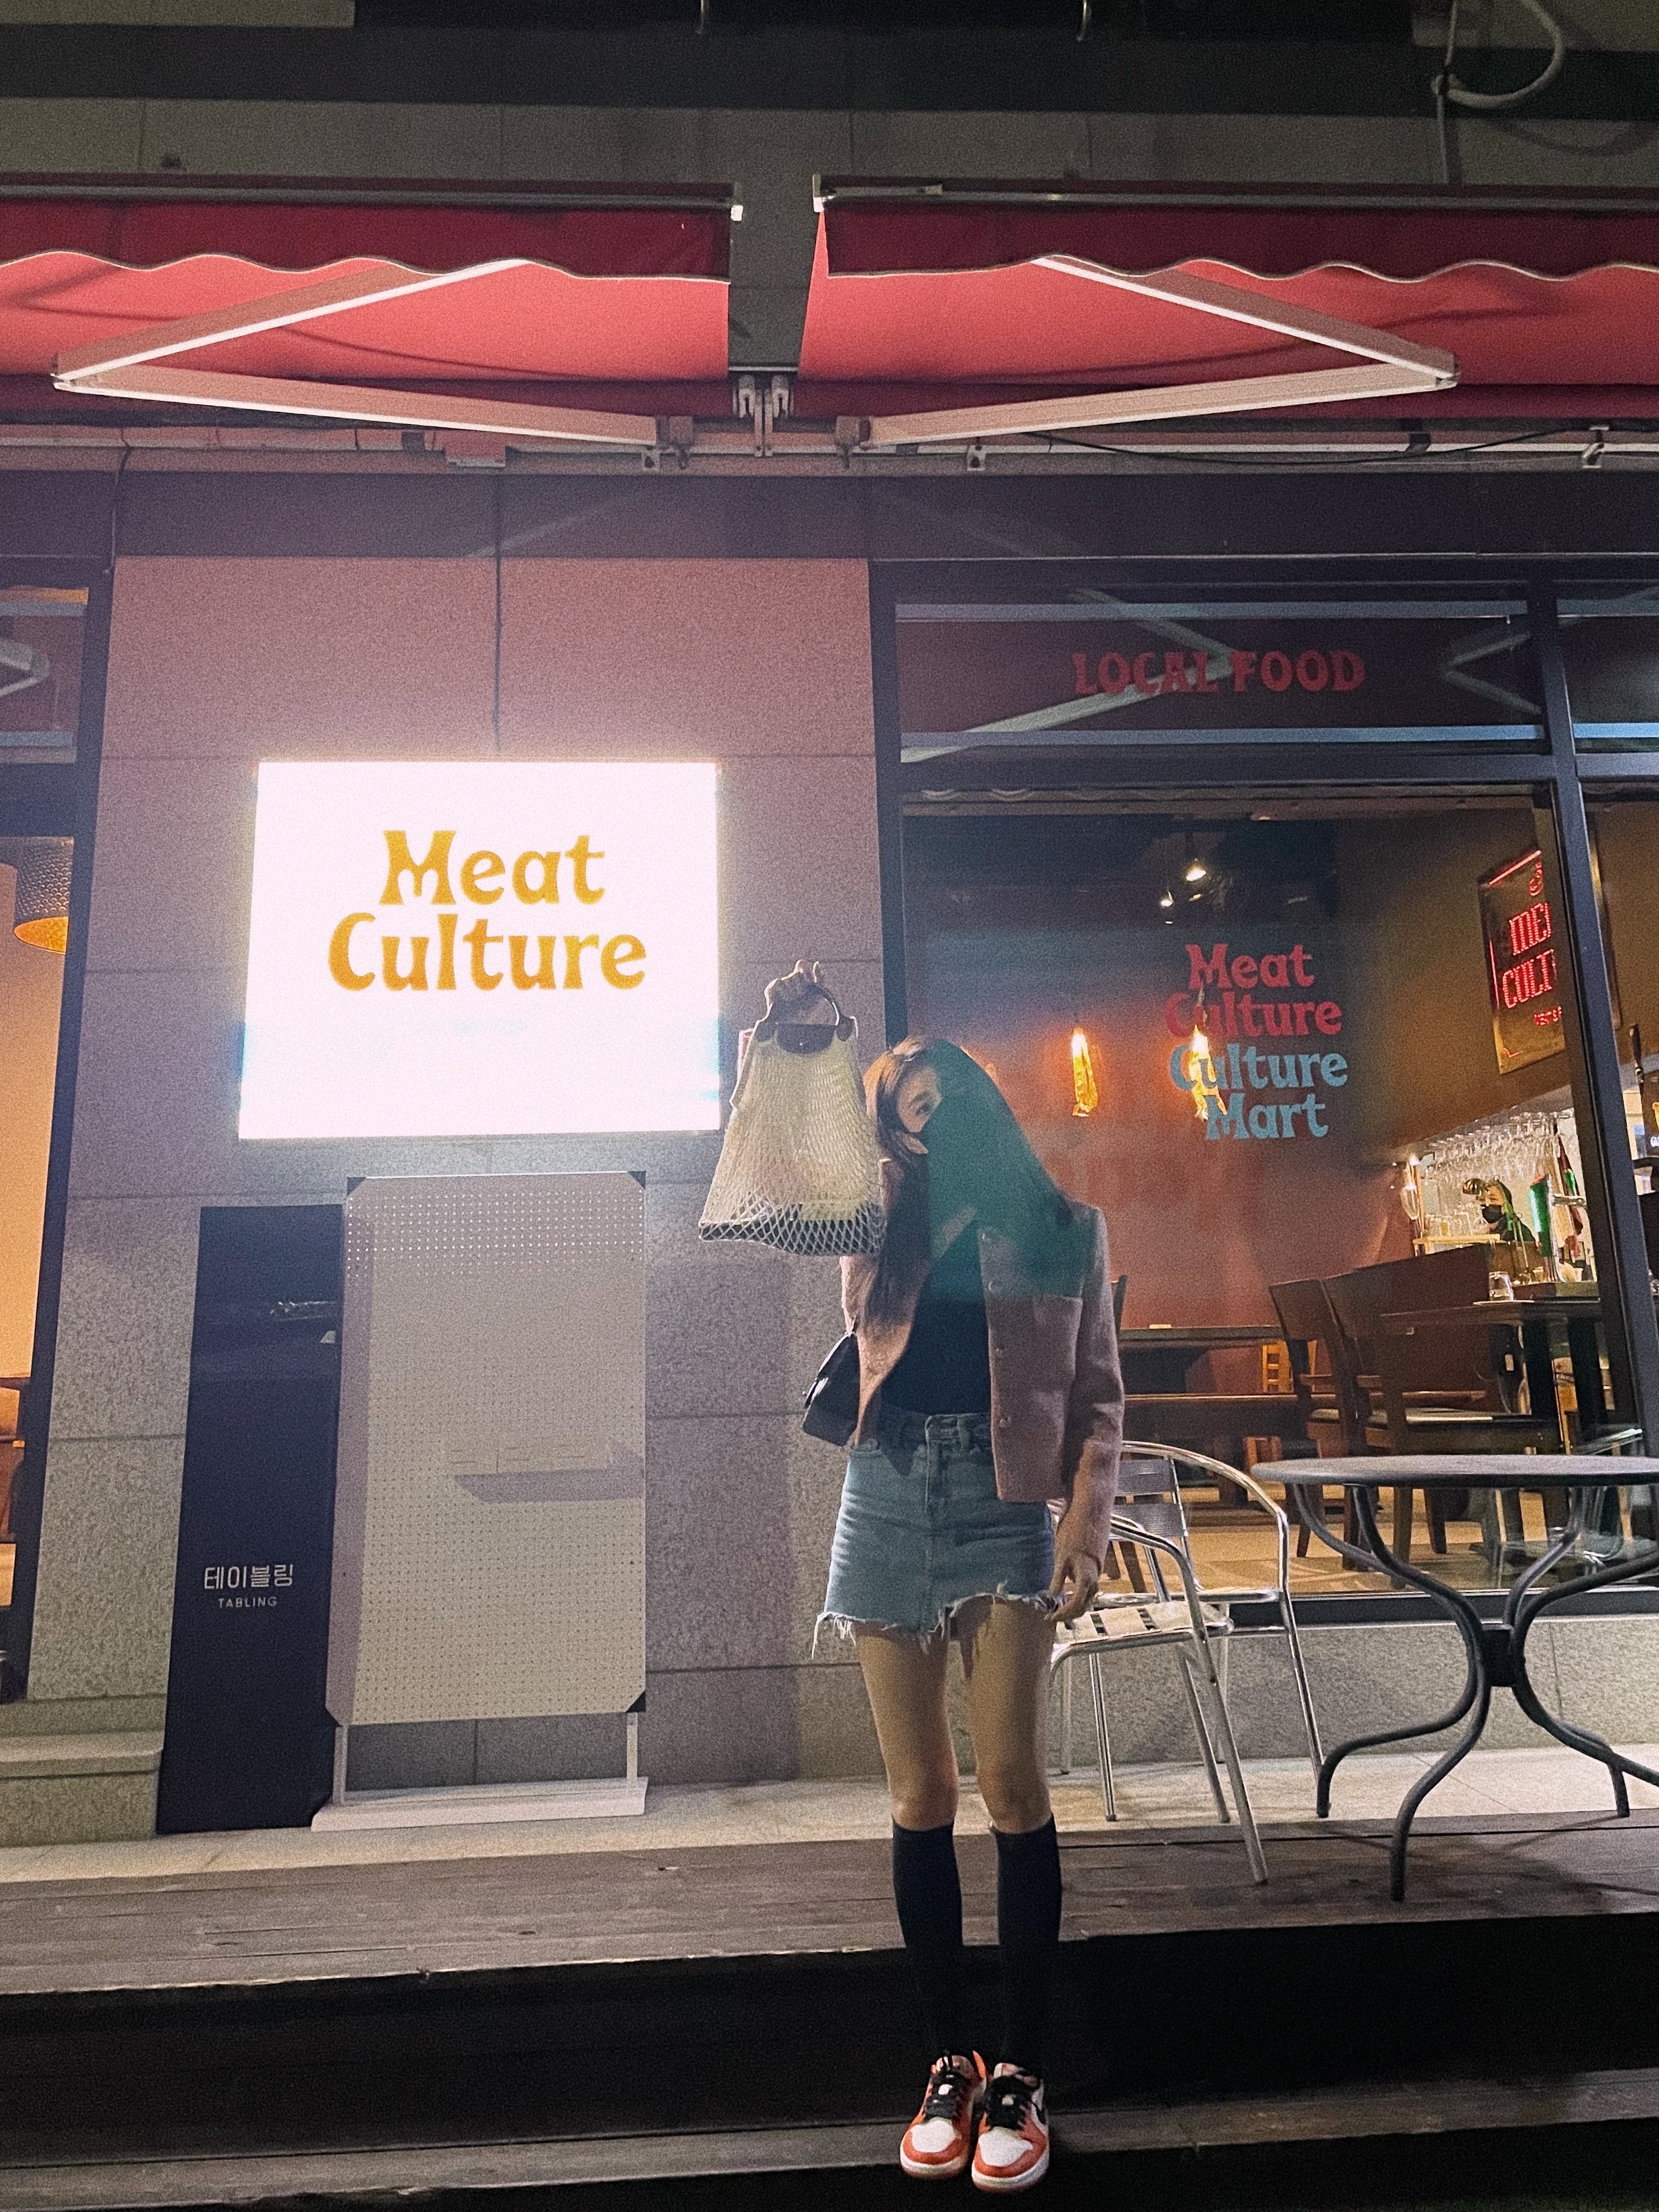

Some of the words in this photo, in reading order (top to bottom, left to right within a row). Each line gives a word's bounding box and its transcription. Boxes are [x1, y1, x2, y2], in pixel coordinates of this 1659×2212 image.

[1071, 651, 1219, 696] LOCAL
[1229, 649, 1365, 692] FOOD
[378, 830, 606, 905] Meat
[328, 912, 647, 991] Culture
[1185, 942, 1315, 990] Meat
[1166, 991, 1342, 1038] Culture
[1168, 1042, 1349, 1092] Culture
[1206, 1092, 1329, 1141] Mart
[204, 1564, 293, 1590] 테이블링
[218, 1596, 278, 1609] TABLING
